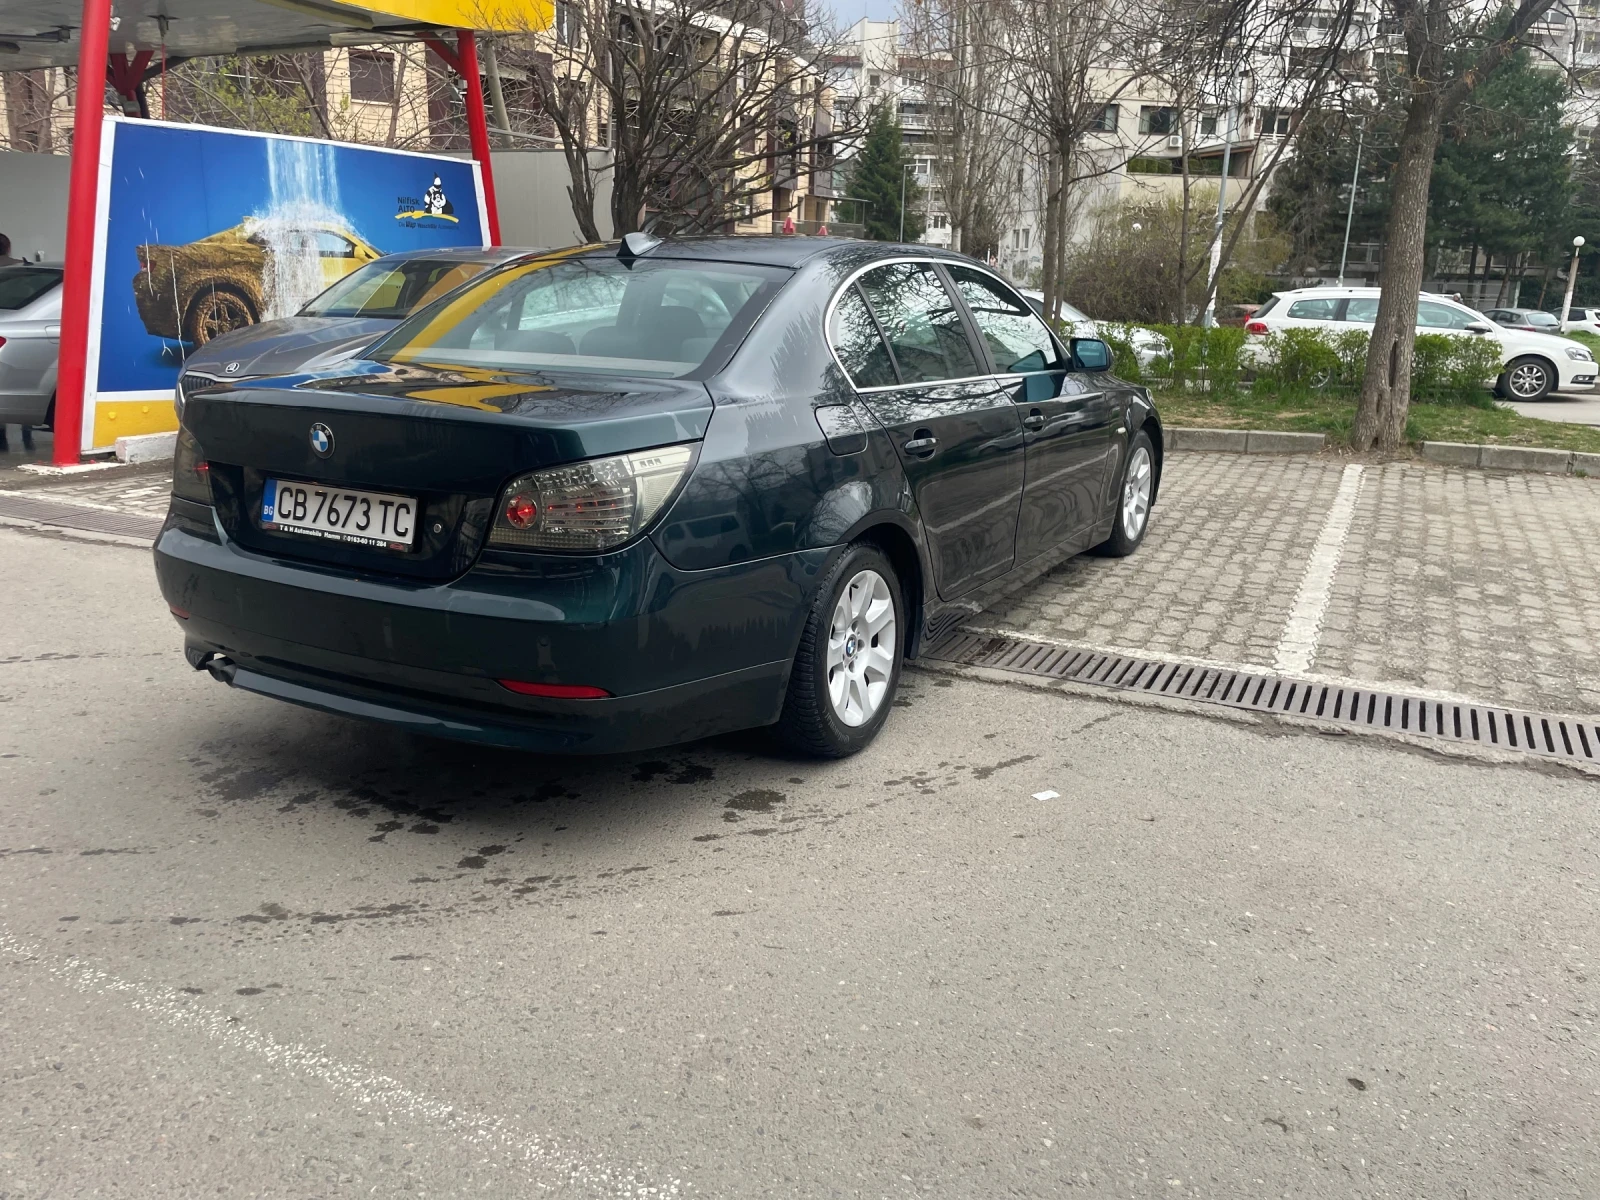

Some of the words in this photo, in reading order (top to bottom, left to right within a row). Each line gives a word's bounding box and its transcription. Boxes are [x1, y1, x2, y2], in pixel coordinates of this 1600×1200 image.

[397, 196, 420, 206] Nilfisk
[398, 205, 415, 213] ALTO
[263, 504, 274, 517] BG
[278, 486, 308, 521] CB
[312, 491, 371, 531] 7673
[378, 499, 411, 538] TC
